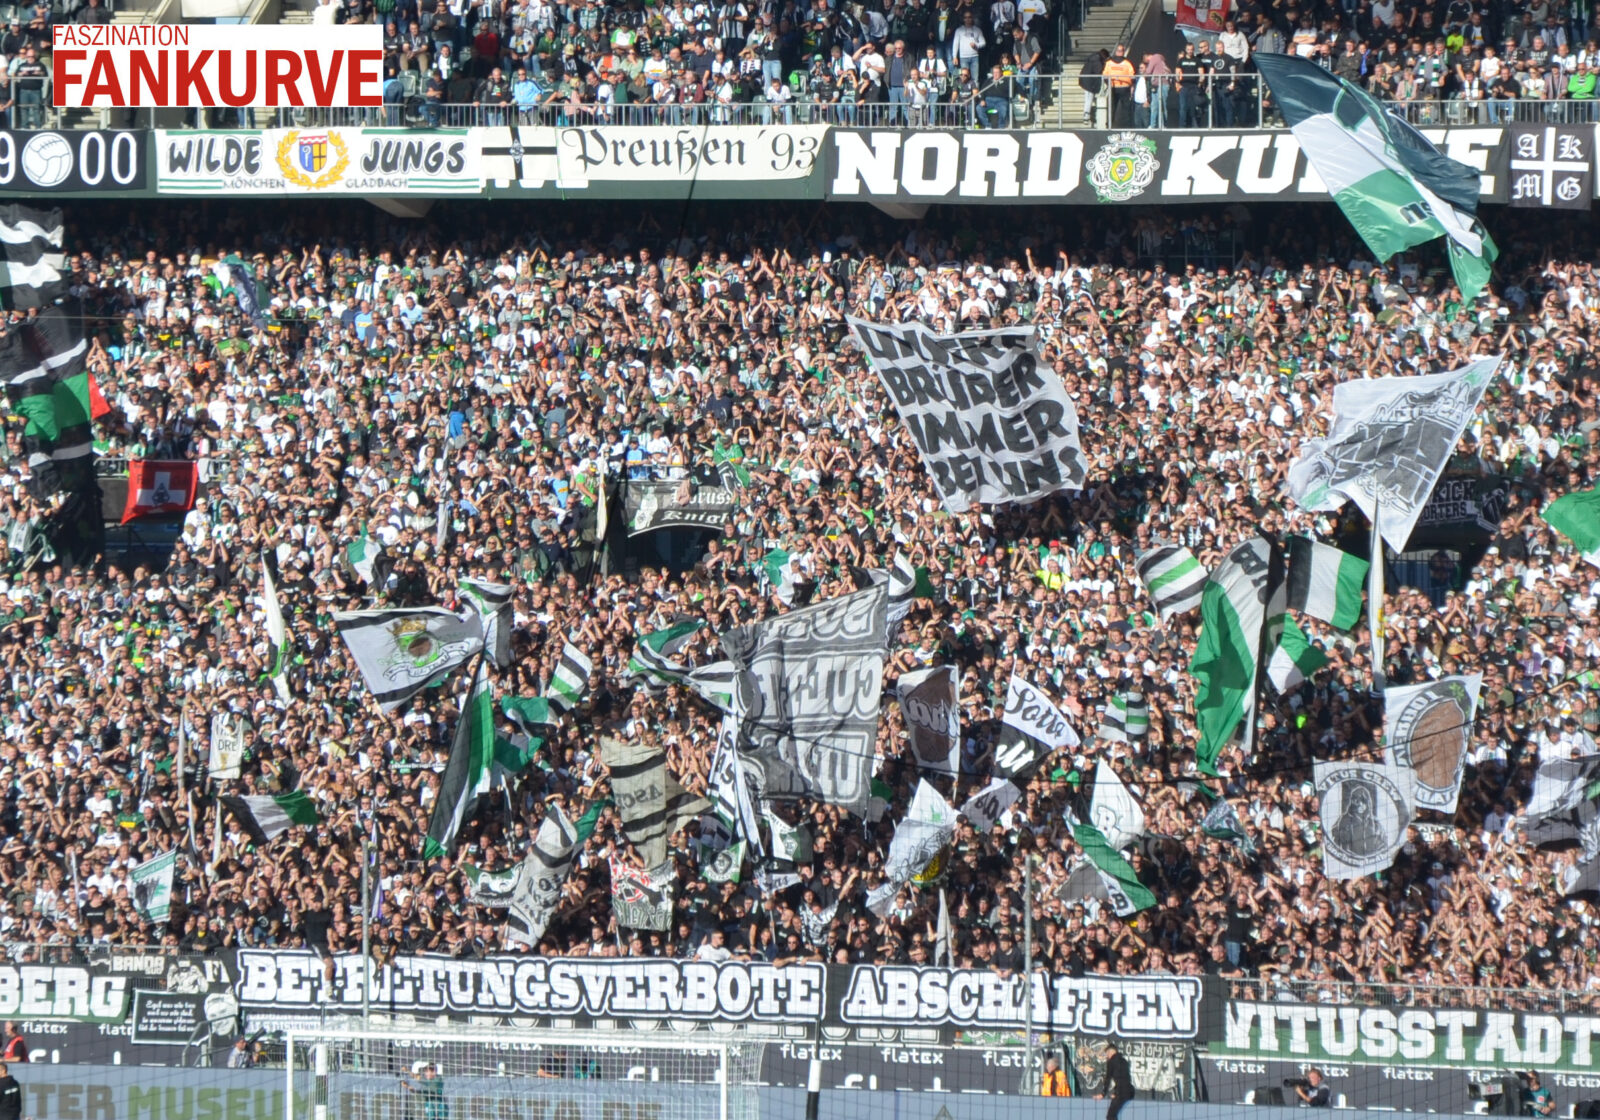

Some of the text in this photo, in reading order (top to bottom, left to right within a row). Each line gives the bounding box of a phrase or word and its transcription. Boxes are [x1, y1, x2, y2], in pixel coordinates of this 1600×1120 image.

[80, 131, 138, 185] 00
[168, 137, 466, 175] WILDE JUNGS
[562, 128, 746, 175] Preußen
[832, 129, 1503, 198] NORD KUE
[1517, 133, 1540, 159] A
[223, 178, 408, 189] MÖNCHEN GLADBACH
[1512, 173, 1542, 200] M
[881, 352, 1046, 411] BRÜDER
[905, 400, 1071, 455] IMMER
[989, 446, 1086, 497] UNS
[1318, 770, 1357, 791] VITUS
[242, 953, 820, 1015] BETRETUNGSVERBOTE
[846, 968, 1196, 1031] ABSCHAFFEN
[22, 1022, 68, 1034] flatex
[881, 1048, 944, 1064] flatex
[1216, 1060, 1266, 1074] flatex
[1383, 1066, 1434, 1080] flatex
